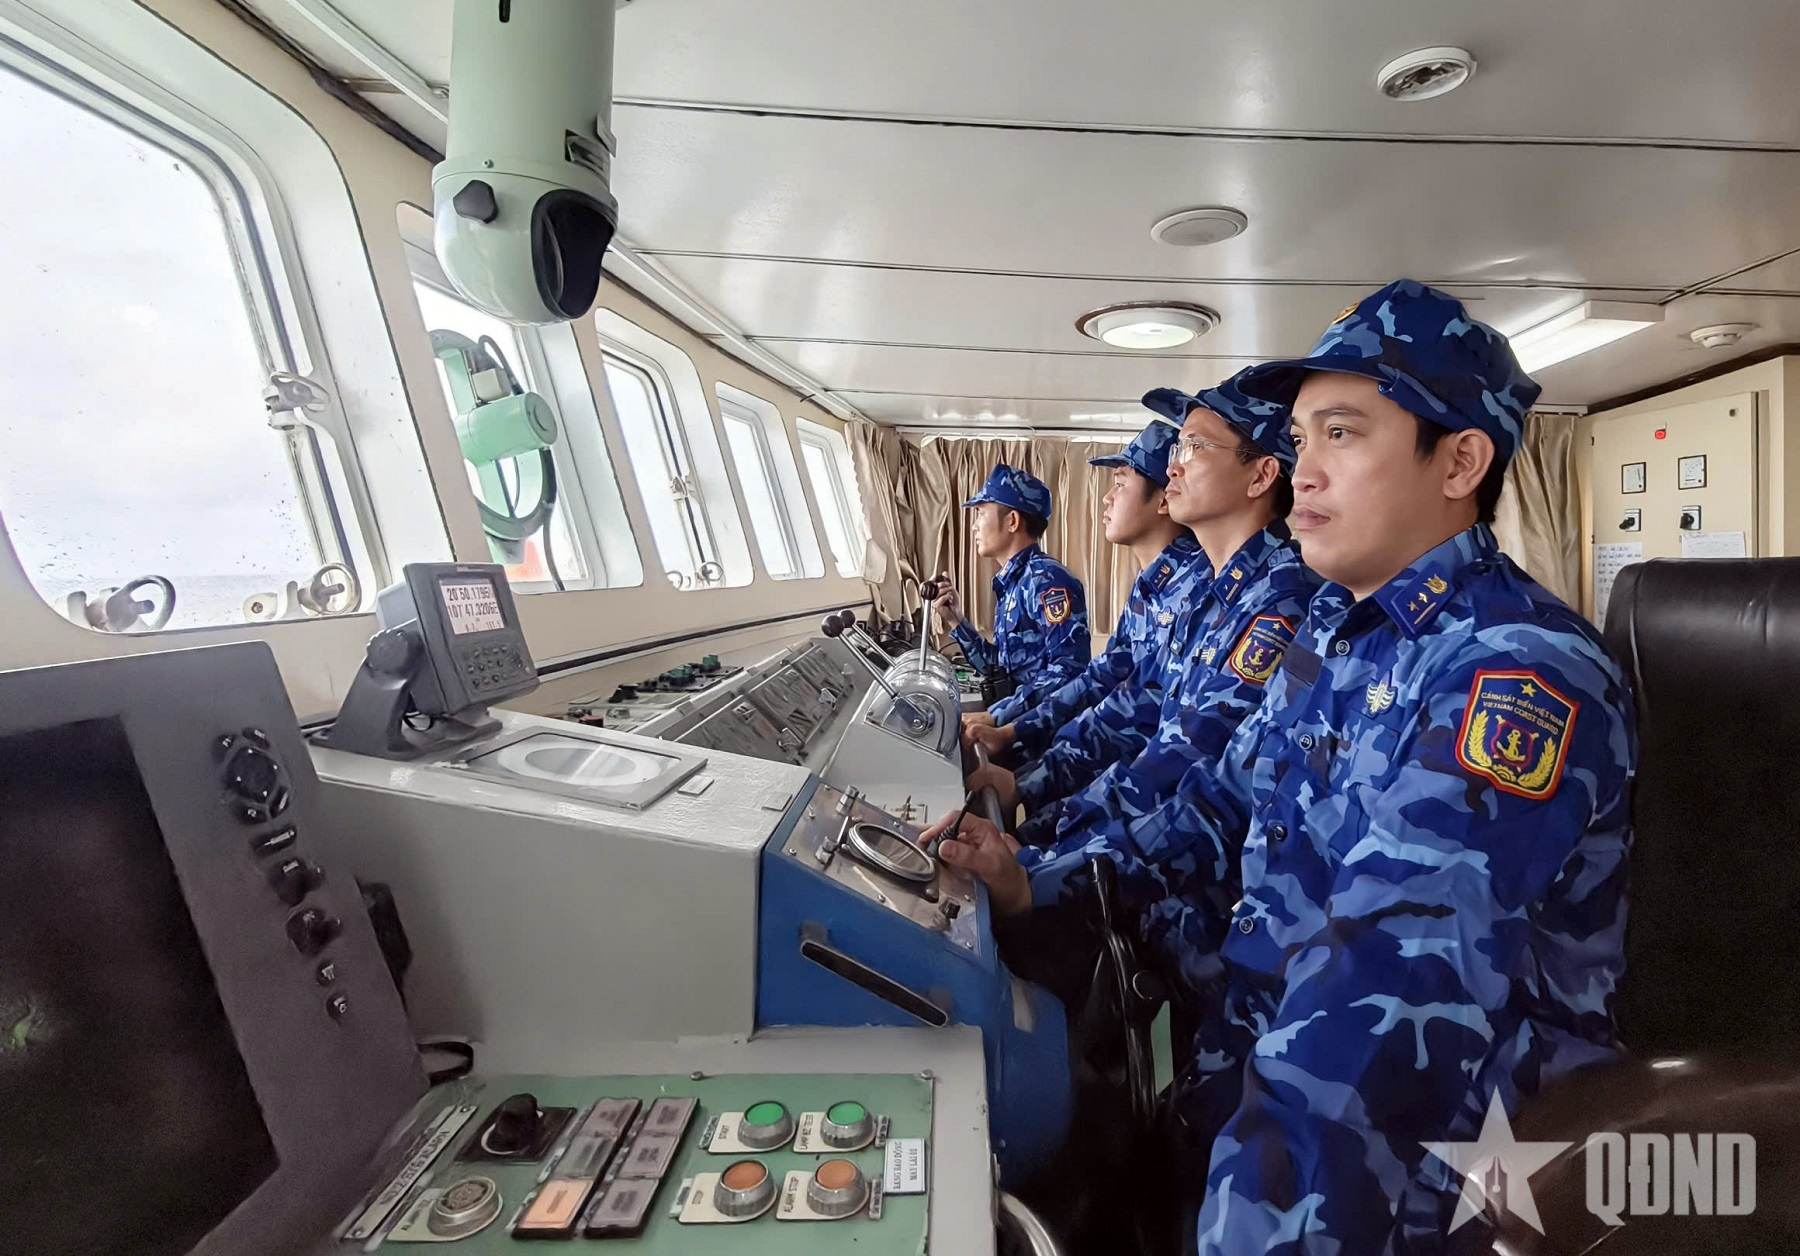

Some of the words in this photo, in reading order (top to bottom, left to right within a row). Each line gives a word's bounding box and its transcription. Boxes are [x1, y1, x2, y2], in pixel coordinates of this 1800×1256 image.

[1501, 693, 1516, 703] SÁT
[1483, 701, 1514, 712] VIETNAM
[1514, 707, 1537, 723] COAST
[1536, 719, 1558, 735] GUARD
